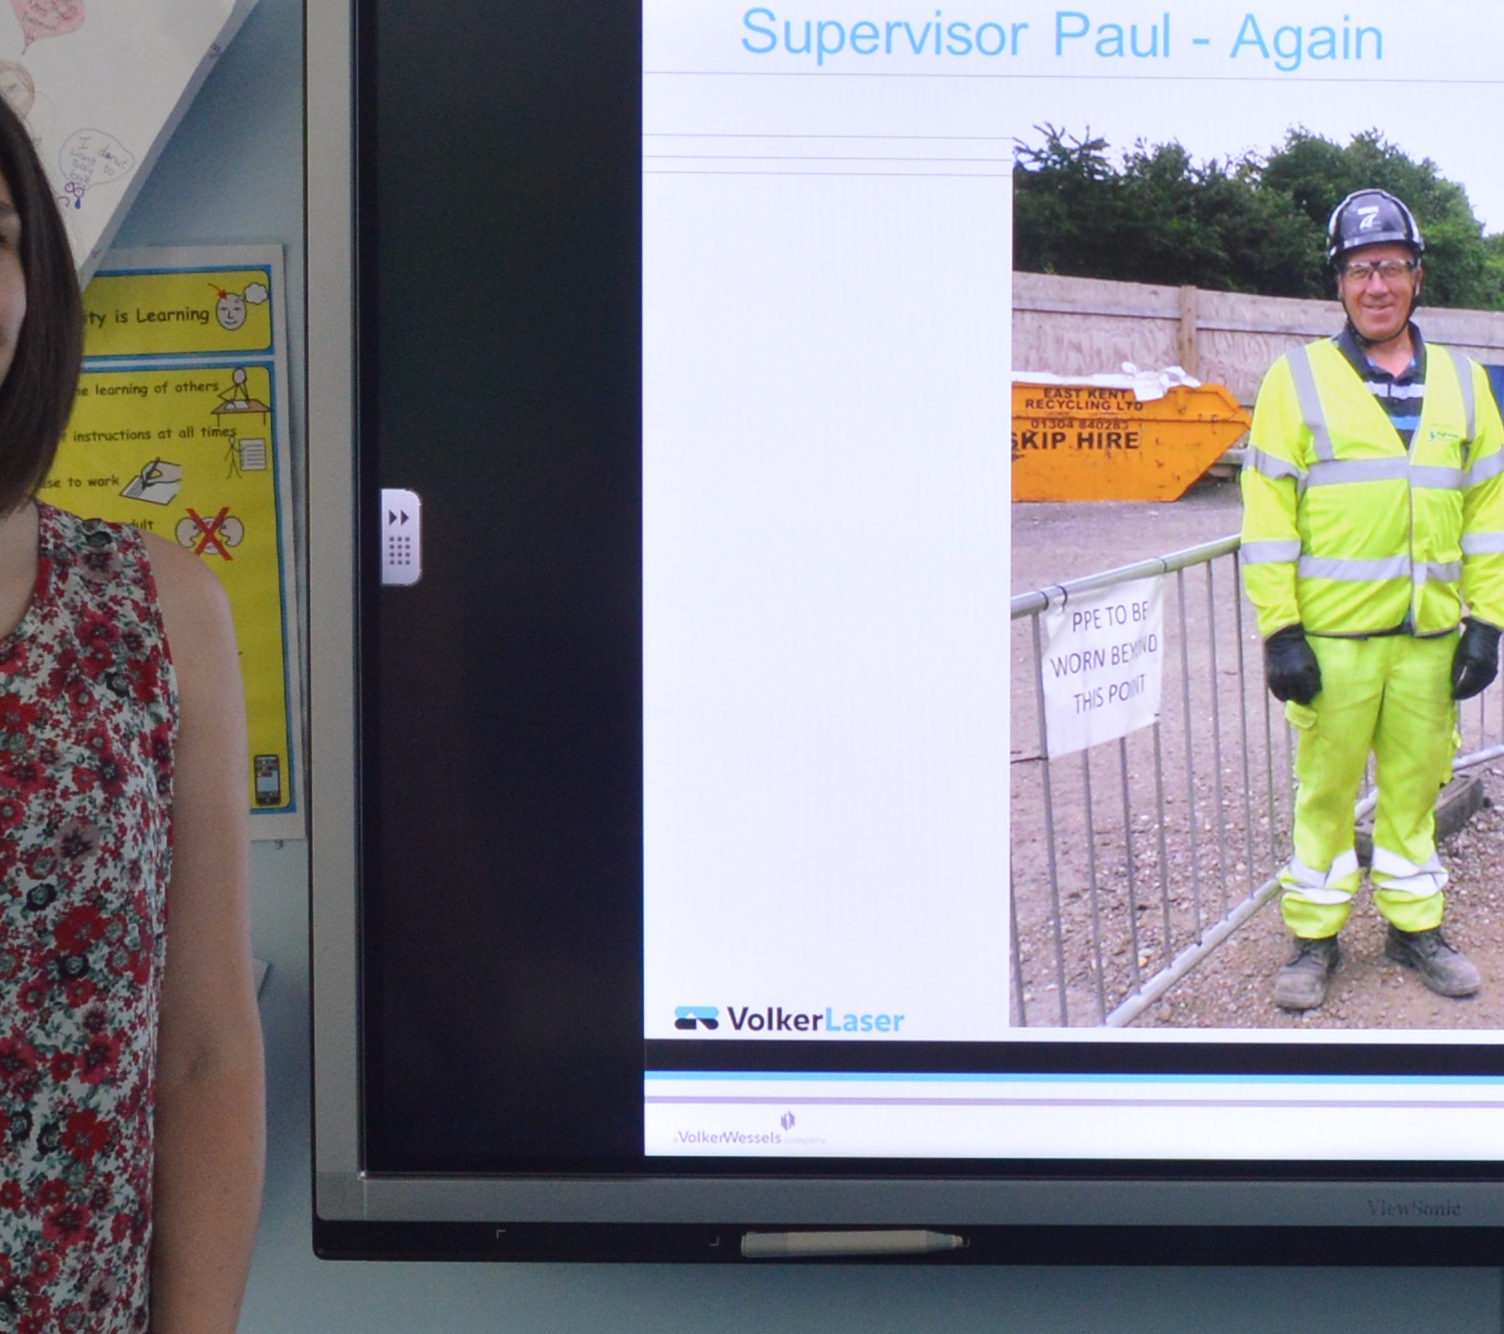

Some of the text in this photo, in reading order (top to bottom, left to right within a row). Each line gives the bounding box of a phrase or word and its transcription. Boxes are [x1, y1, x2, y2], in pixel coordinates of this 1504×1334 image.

[741, 8, 1029, 65] Supervisor
[1055, 11, 1172, 58] Paul
[1230, 13, 1383, 71] Again
[115, 307, 210, 328] is Learning
[1025, 399, 1111, 411] RECYCLING
[1043, 388, 1127, 400] EAST KENT
[1076, 432, 1139, 450] HIRE
[1072, 600, 1149, 633] PPE TO BE
[1050, 649, 1105, 678] WORN
[1073, 687, 1104, 716] THIS
[727, 1006, 905, 1033] VolkerLaser
[1368, 1199, 1461, 1216] ViewSonic
